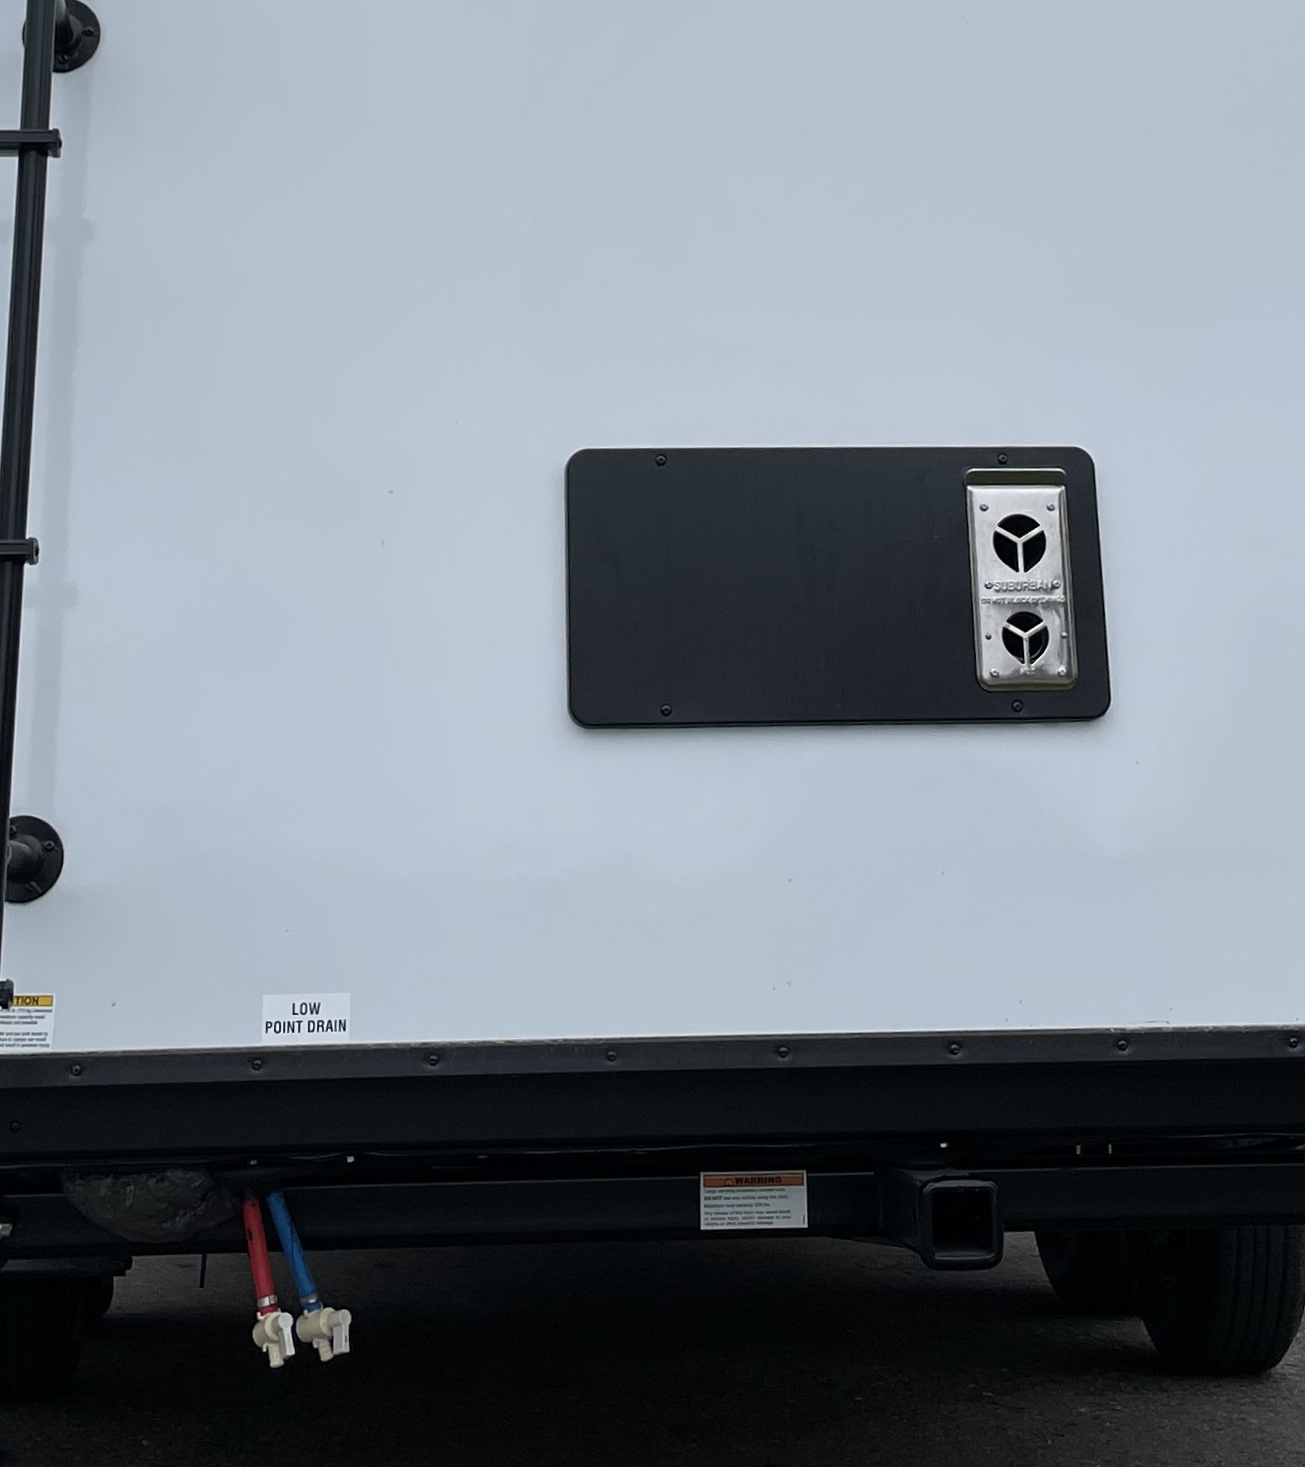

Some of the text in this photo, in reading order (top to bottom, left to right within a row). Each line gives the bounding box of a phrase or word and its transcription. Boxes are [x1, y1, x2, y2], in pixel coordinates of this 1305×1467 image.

[993, 580, 1052, 592] SUBURBAN
[15, 996, 39, 1006] TION
[292, 1002, 322, 1016] LOW
[265, 1019, 347, 1034] POINT DRAIN
[735, 1176, 782, 1185] WARNING
